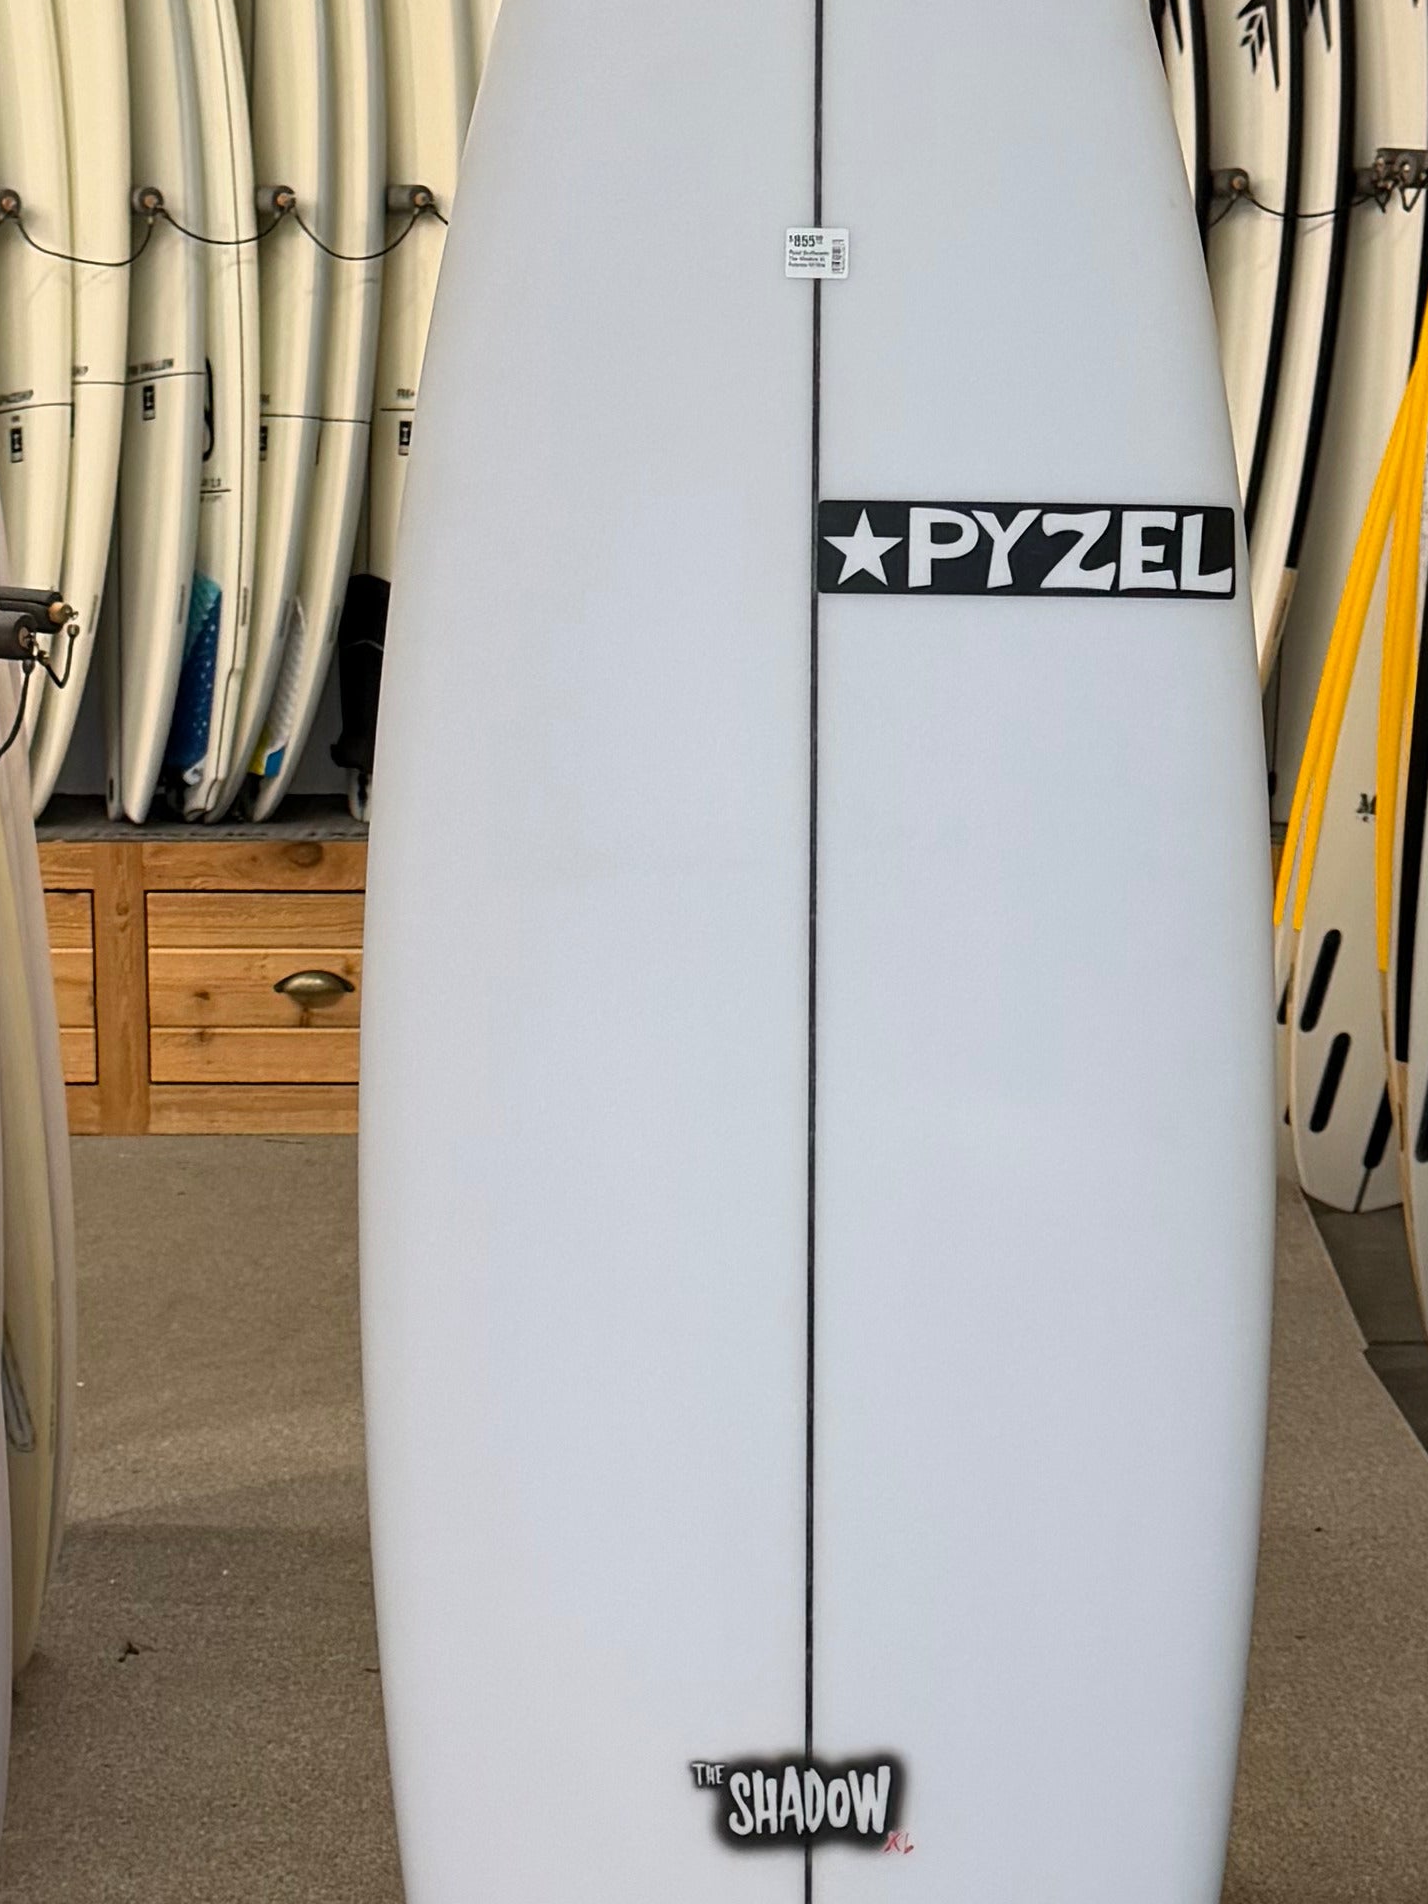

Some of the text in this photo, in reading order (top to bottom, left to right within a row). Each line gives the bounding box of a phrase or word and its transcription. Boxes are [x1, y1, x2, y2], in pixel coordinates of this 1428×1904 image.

[908, 506, 1233, 593] PYZEL
[692, 1763, 725, 1786] THE
[728, 1765, 891, 1836] SHADOW
